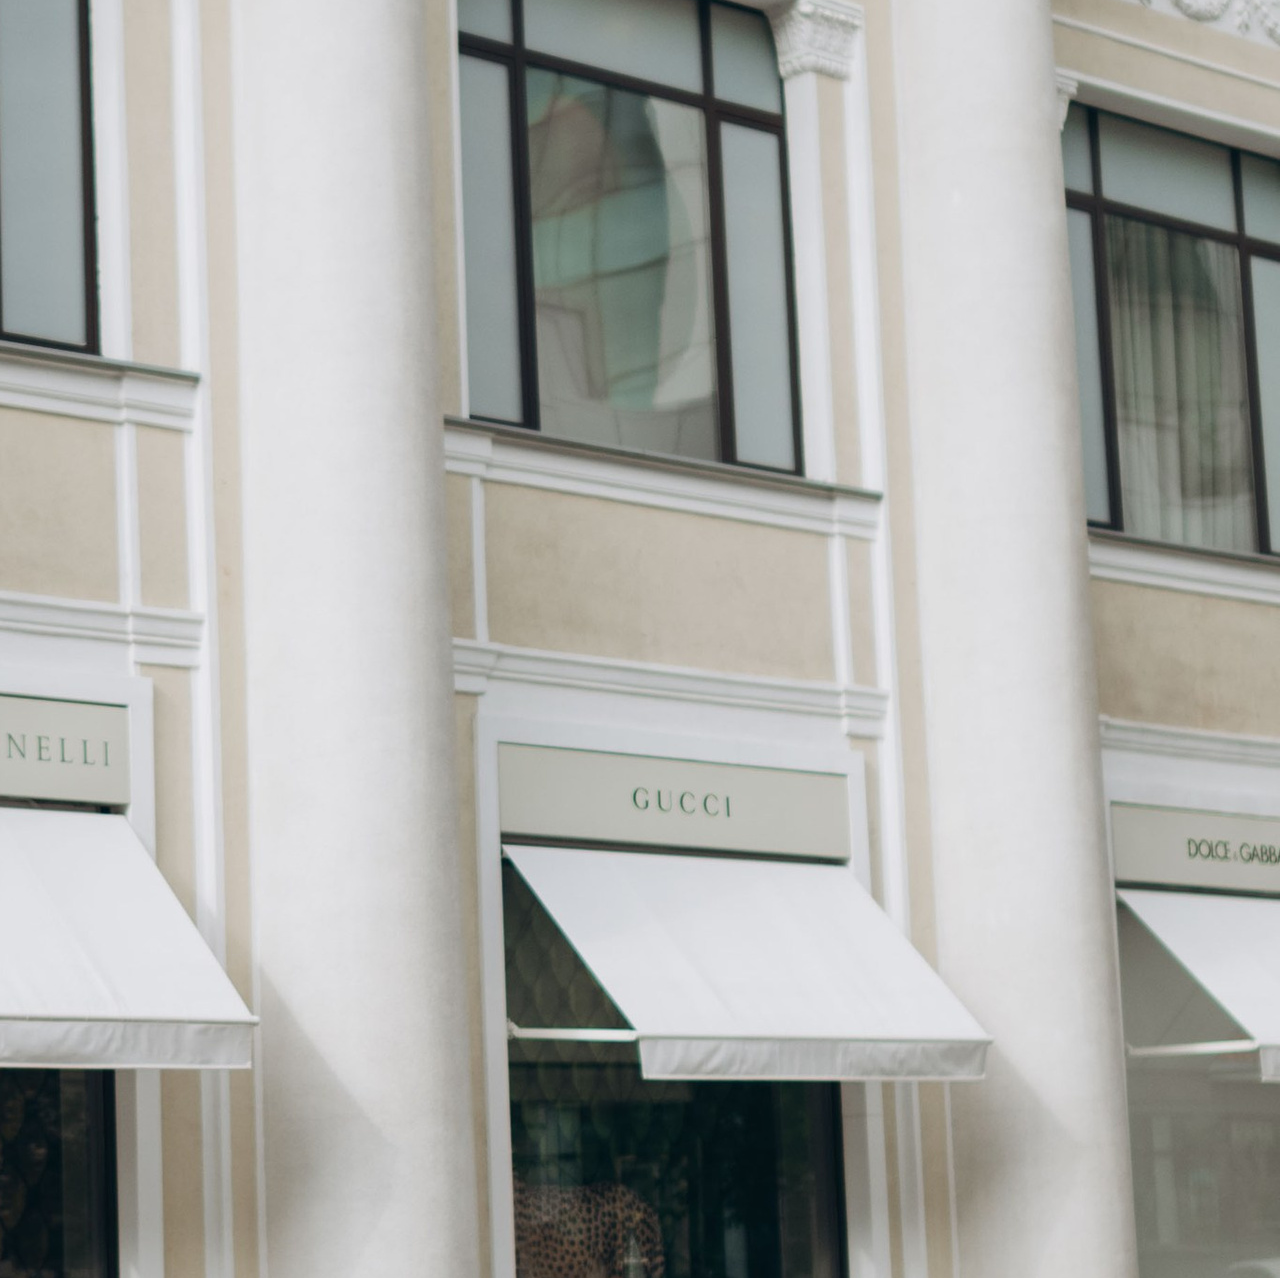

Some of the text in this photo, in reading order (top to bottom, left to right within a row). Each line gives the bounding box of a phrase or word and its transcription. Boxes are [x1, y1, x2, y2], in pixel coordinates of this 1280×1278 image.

[633, 786, 731, 818] GUCCI
[1187, 838, 1230, 860] DOLCE
[1239, 842, 1280, 864] GABB
